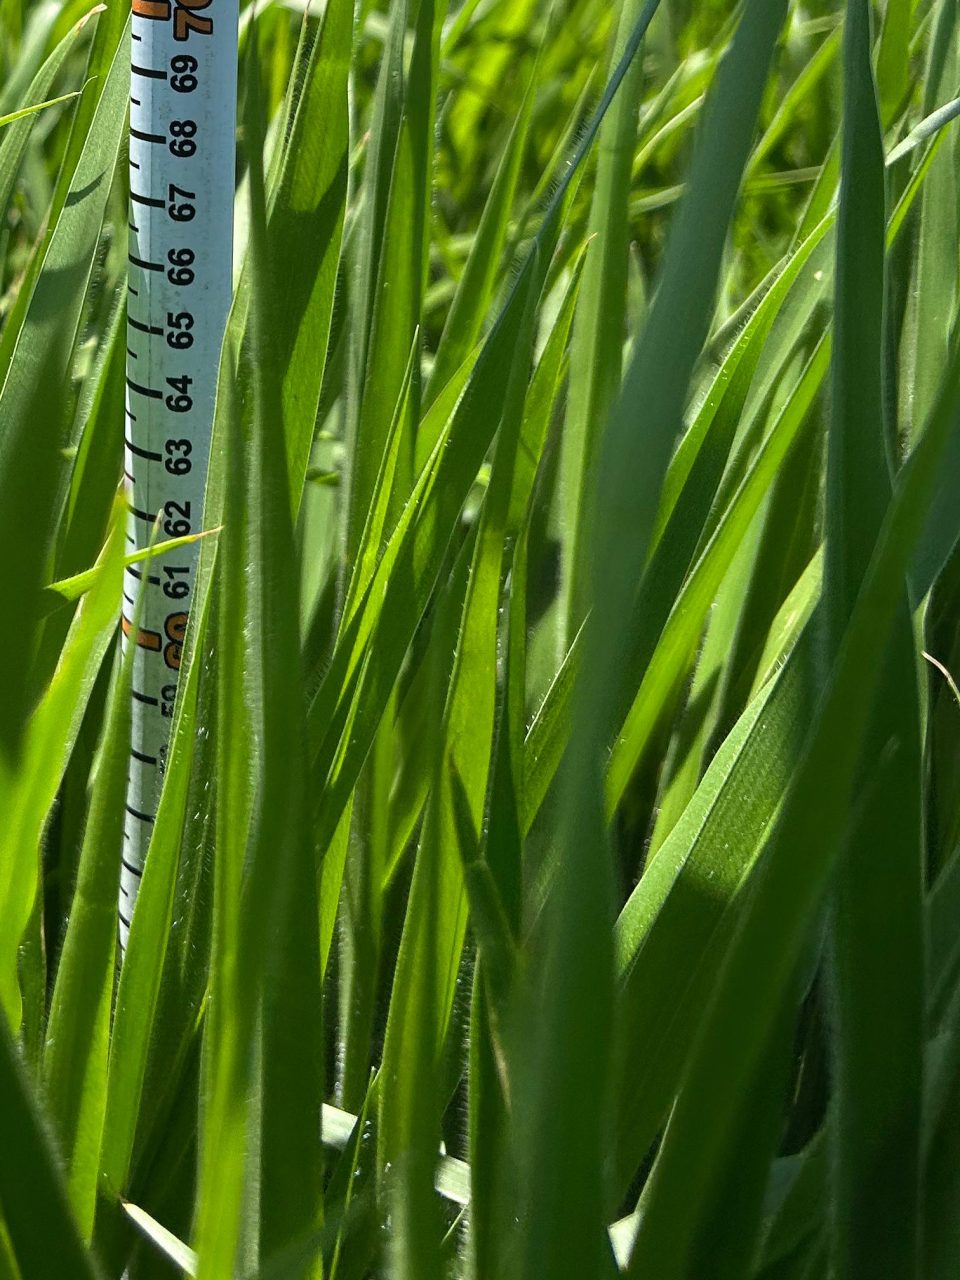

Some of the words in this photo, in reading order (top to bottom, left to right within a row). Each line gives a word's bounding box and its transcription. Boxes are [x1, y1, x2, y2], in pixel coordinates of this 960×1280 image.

[170, 55, 198, 93] 69
[169, 120, 197, 157] 68
[168, 184, 195, 222] 67
[167, 249, 195, 286] 66
[167, 312, 194, 349] 65
[165, 375, 193, 412] 64
[165, 439, 193, 476] 63
[164, 501, 191, 538] 62
[163, 566, 189, 599] 61
